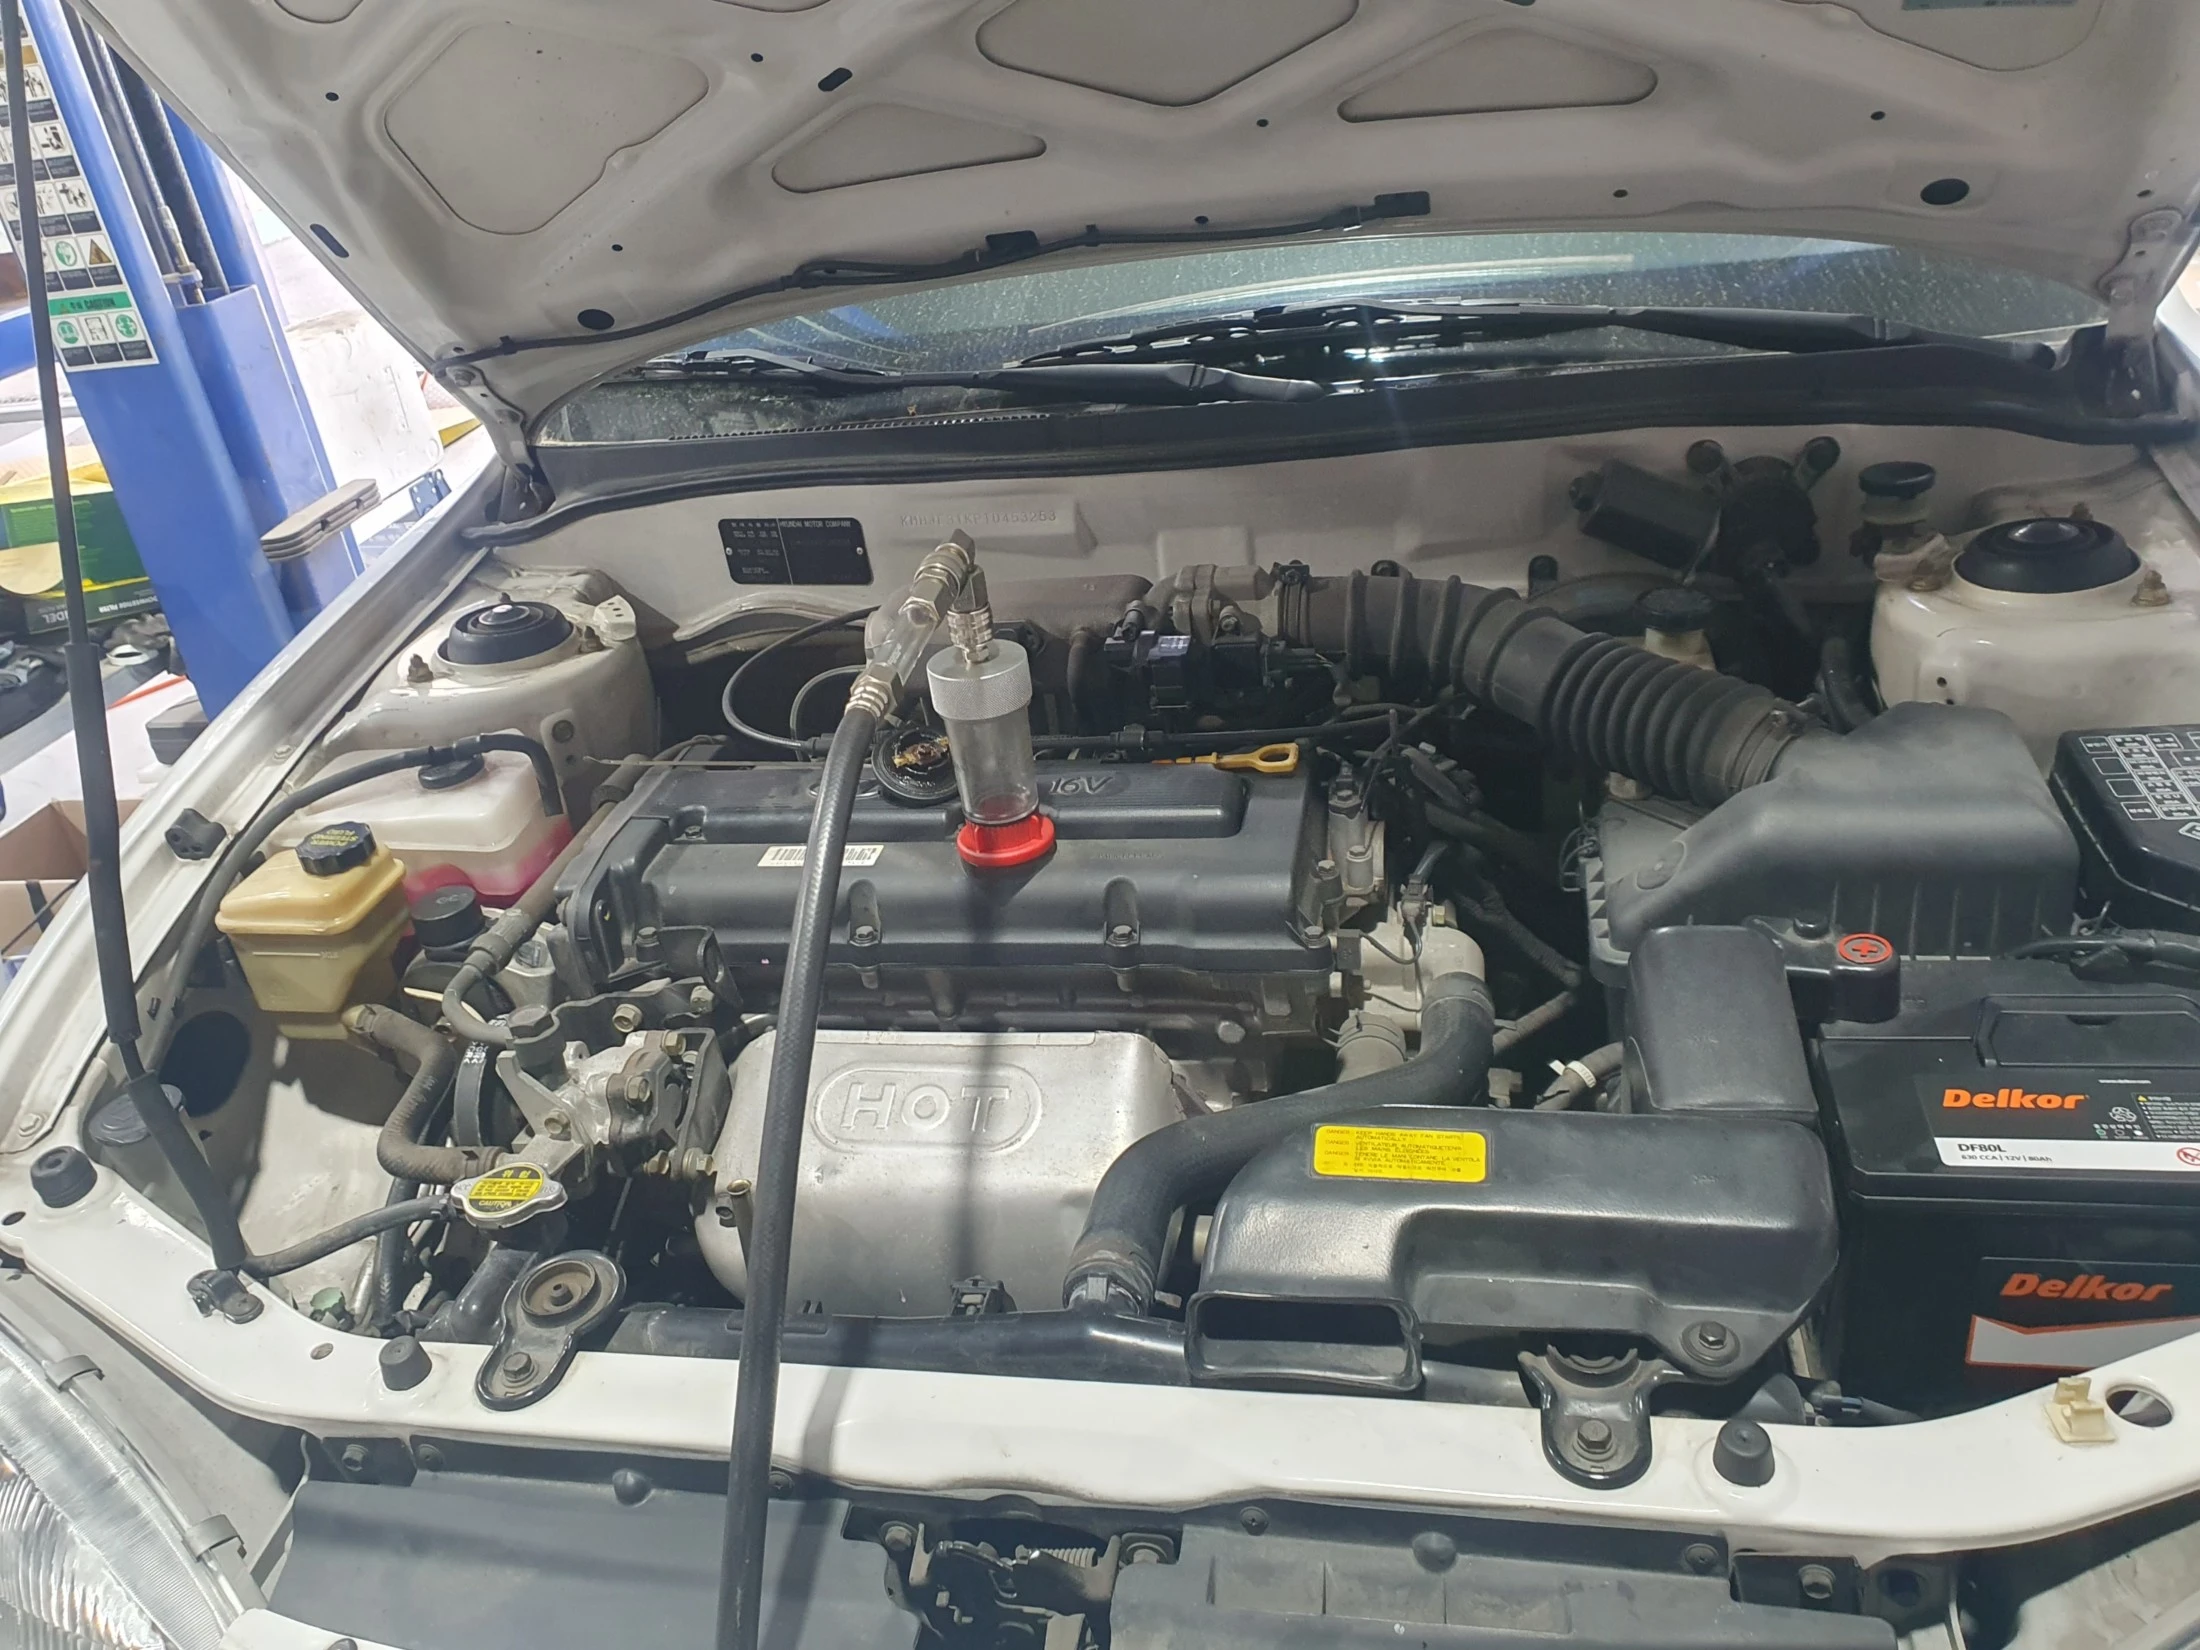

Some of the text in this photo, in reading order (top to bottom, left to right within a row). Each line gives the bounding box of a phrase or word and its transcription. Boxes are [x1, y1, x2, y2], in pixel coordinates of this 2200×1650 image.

[804, 520, 823, 528] MOTOR
[825, 520, 851, 528] COMPANY
[1049, 776, 1113, 795] 16V
[840, 1081, 1010, 1131] HOT
[1942, 1088, 2086, 1109] Delkor
[1957, 1142, 2007, 1153] DF80L
[479, 1200, 512, 1208] CAUTION
[2000, 1273, 2174, 1301] Delkor
